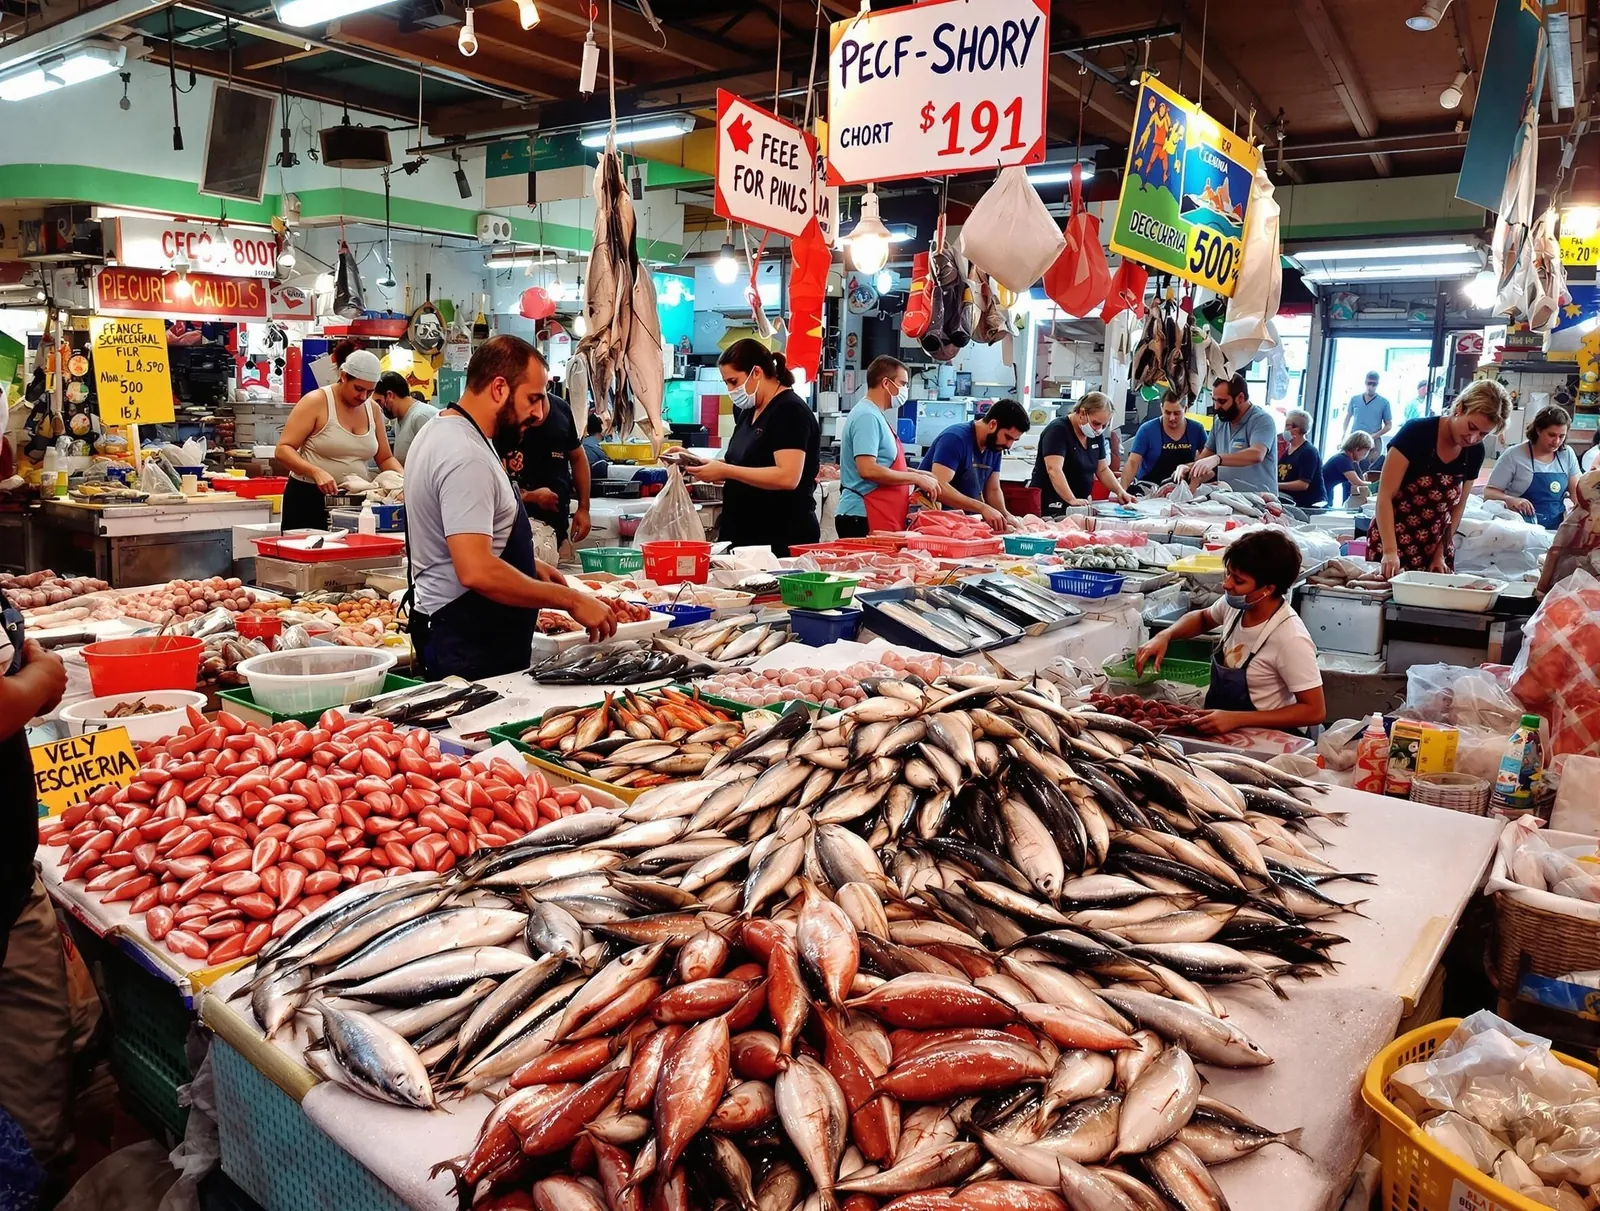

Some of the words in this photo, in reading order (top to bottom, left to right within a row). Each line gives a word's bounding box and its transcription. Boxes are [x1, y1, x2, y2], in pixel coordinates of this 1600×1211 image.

[839, 16, 1041, 89] PECF-SHORY
[840, 121, 894, 148] CHORT
[919, 96, 1027, 156] $191
[760, 132, 799, 170] FEEE
[733, 164, 764, 200] FOR
[769, 176, 808, 215] PINLS
[1189, 229, 1234, 286] 500
[102, 272, 174, 304] PIECURL
[189, 279, 260, 310] CAUDLS
[120, 379, 143, 394] 500
[44, 734, 96, 765] VELY
